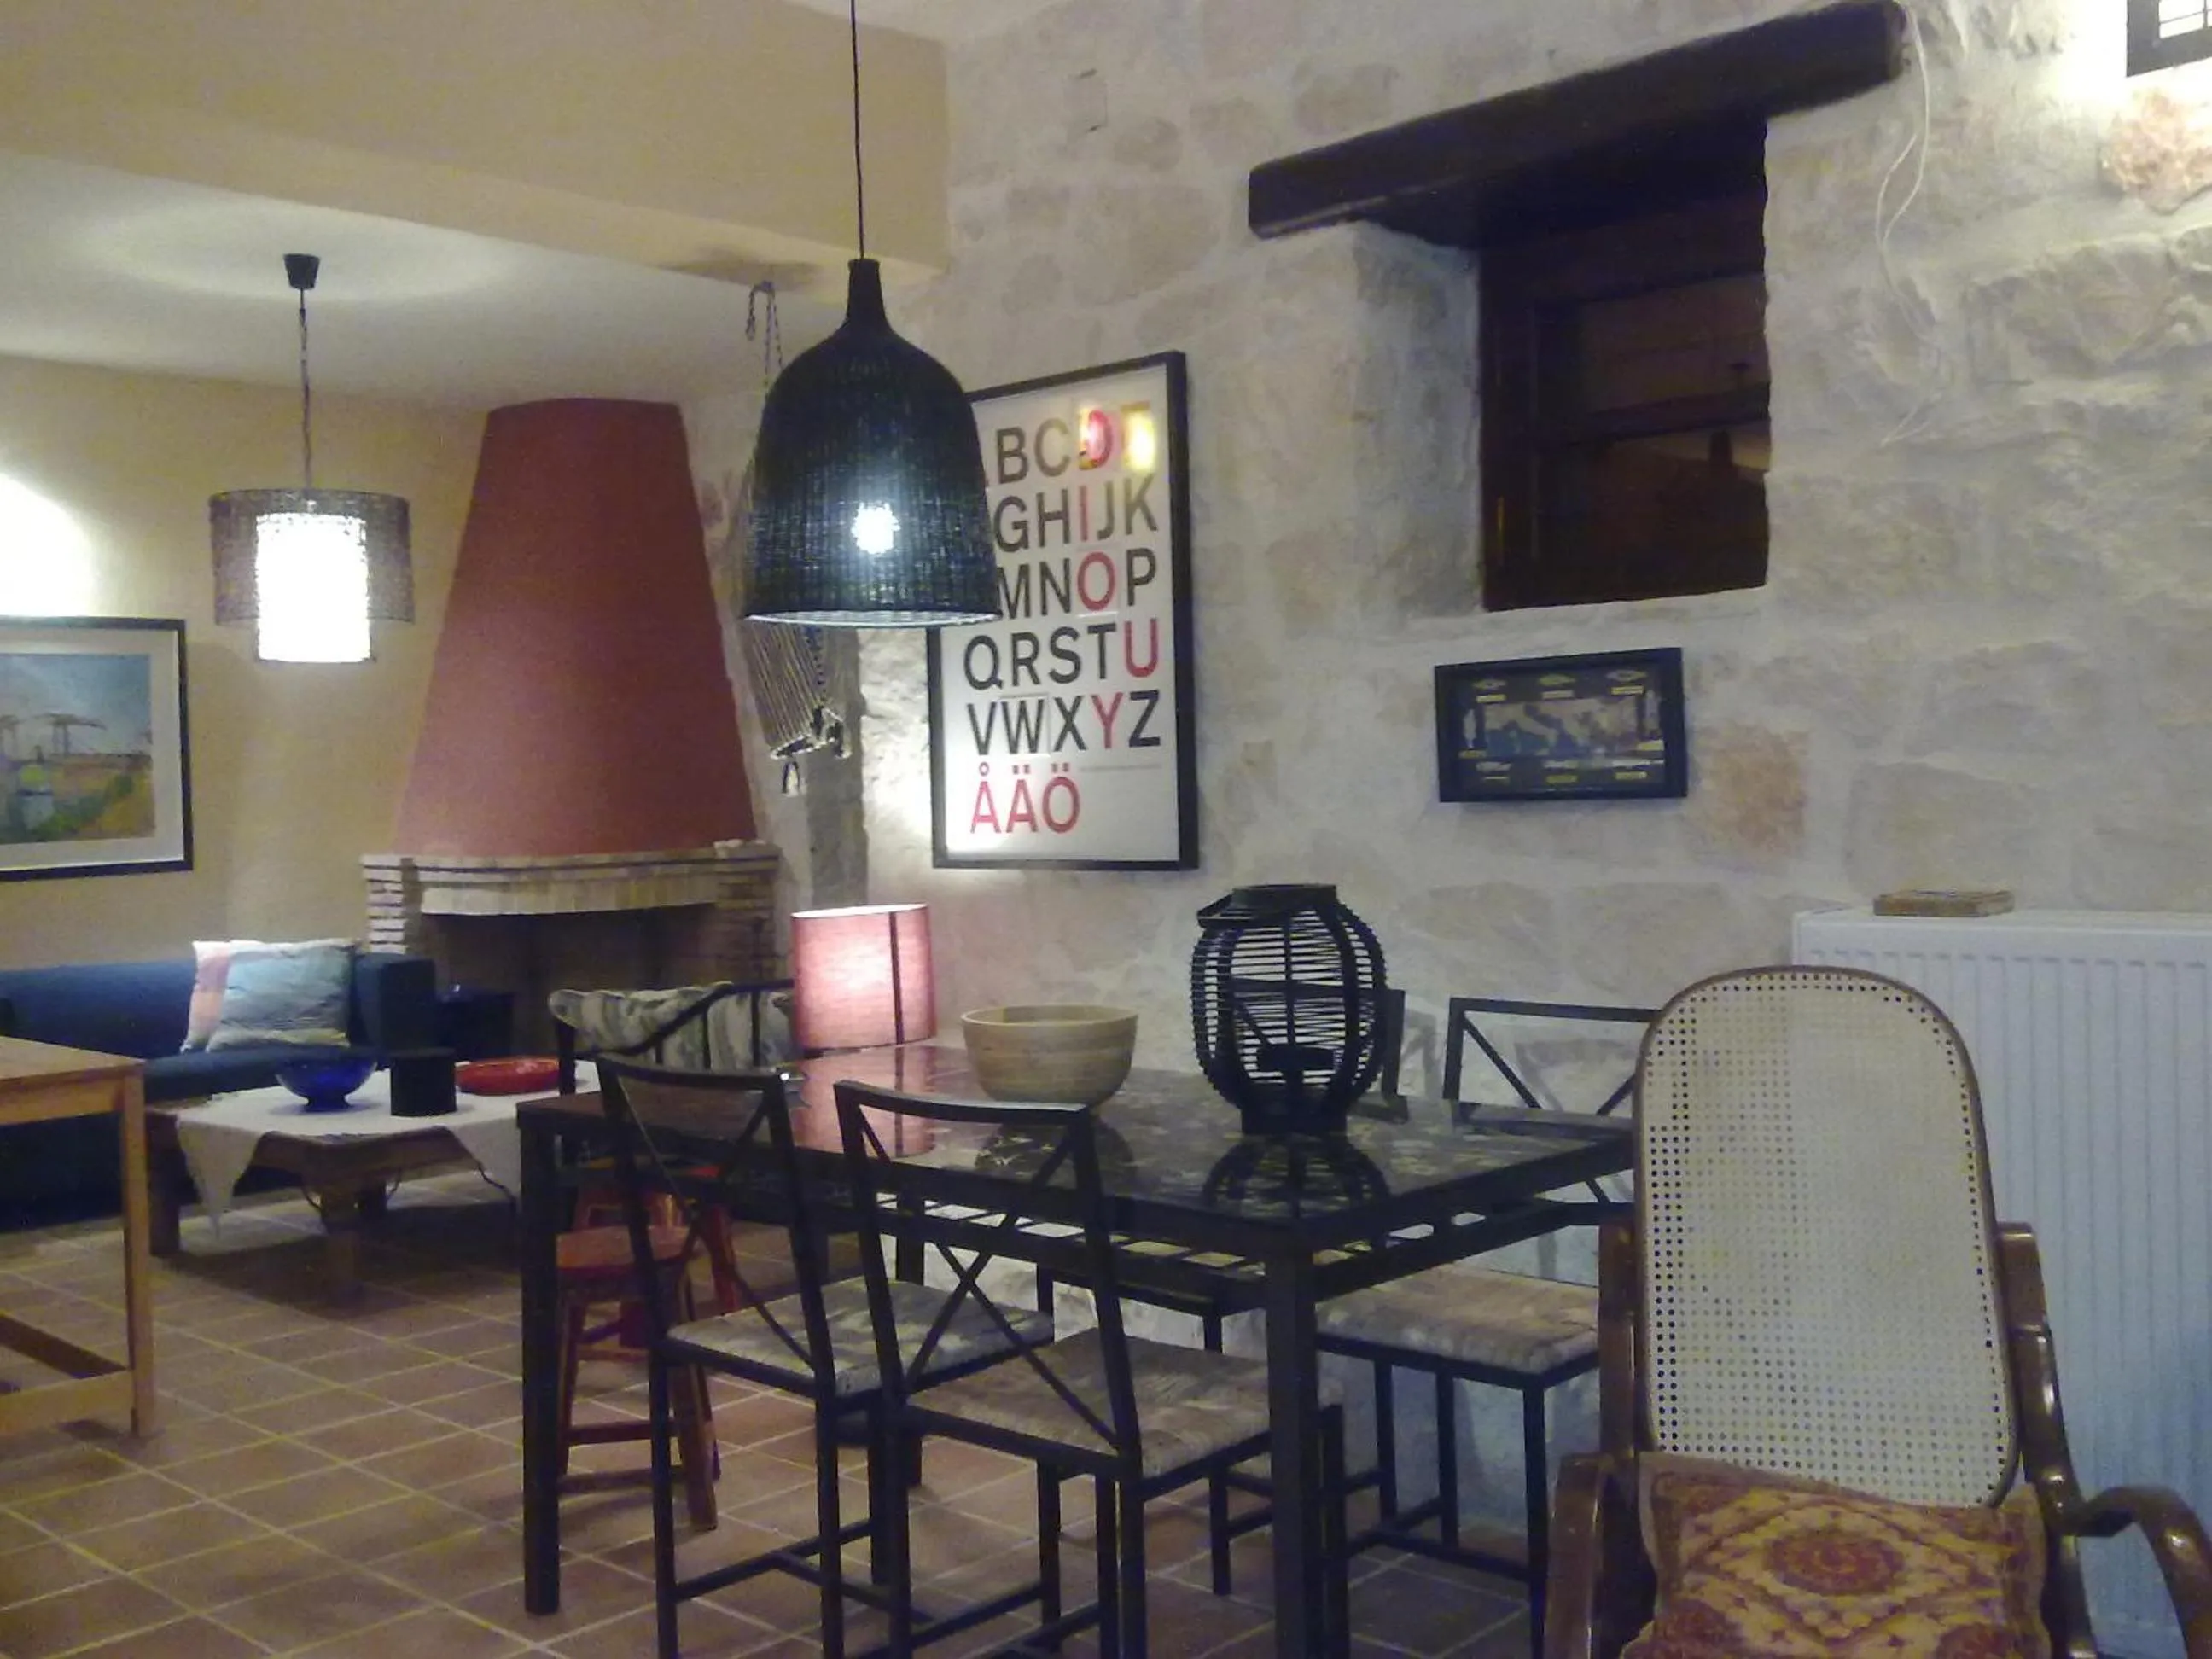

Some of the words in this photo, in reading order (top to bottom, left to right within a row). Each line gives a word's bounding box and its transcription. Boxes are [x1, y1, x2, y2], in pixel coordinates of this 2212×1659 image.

[984, 400, 1155, 487] BCD
[992, 470, 1158, 553] GHIJK
[995, 547, 1156, 620] MNOP
[963, 617, 1160, 690] QRSTU
[966, 689, 1161, 756] VWXYZ
[969, 761, 1081, 834] ÅÄÖ
